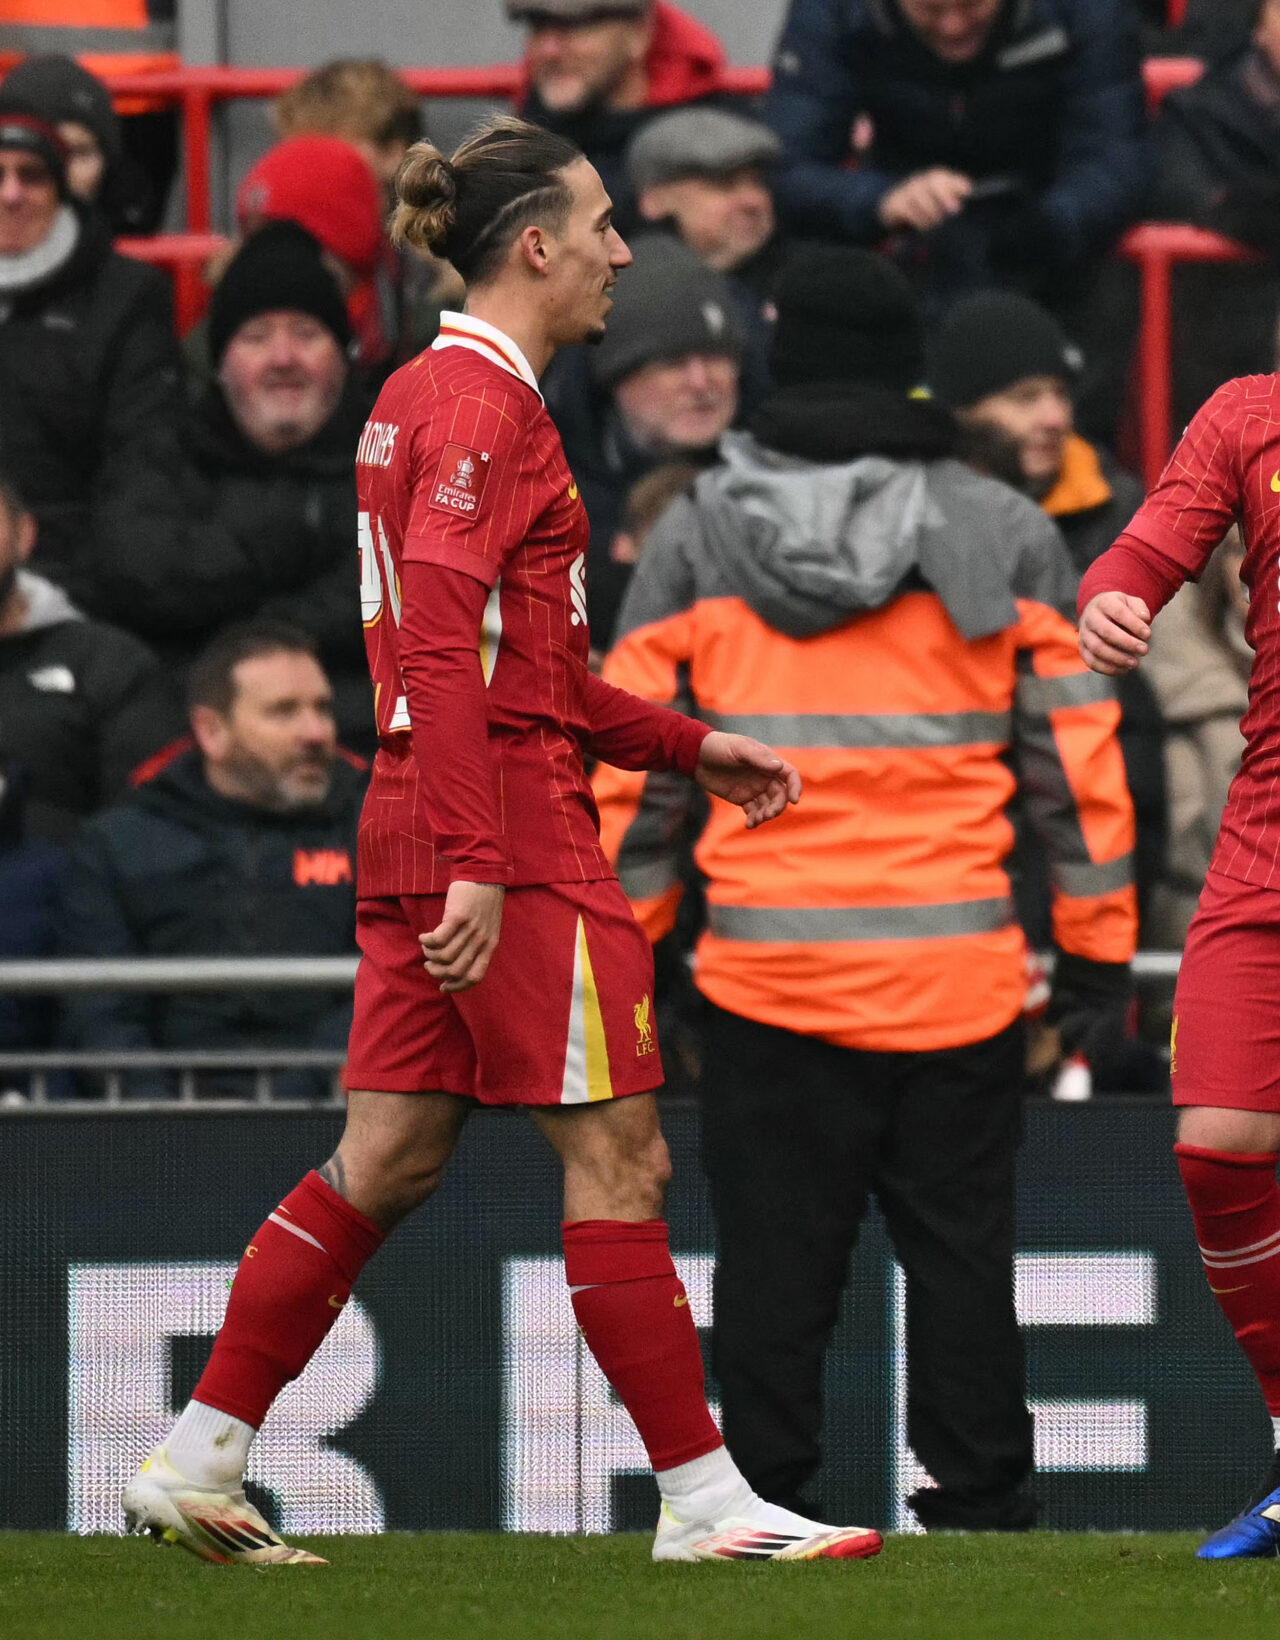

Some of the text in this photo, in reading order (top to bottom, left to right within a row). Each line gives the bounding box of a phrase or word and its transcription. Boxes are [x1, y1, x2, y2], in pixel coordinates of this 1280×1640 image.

[435, 493, 475, 511] FA CUP
[438, 484, 477, 503] Emirates
